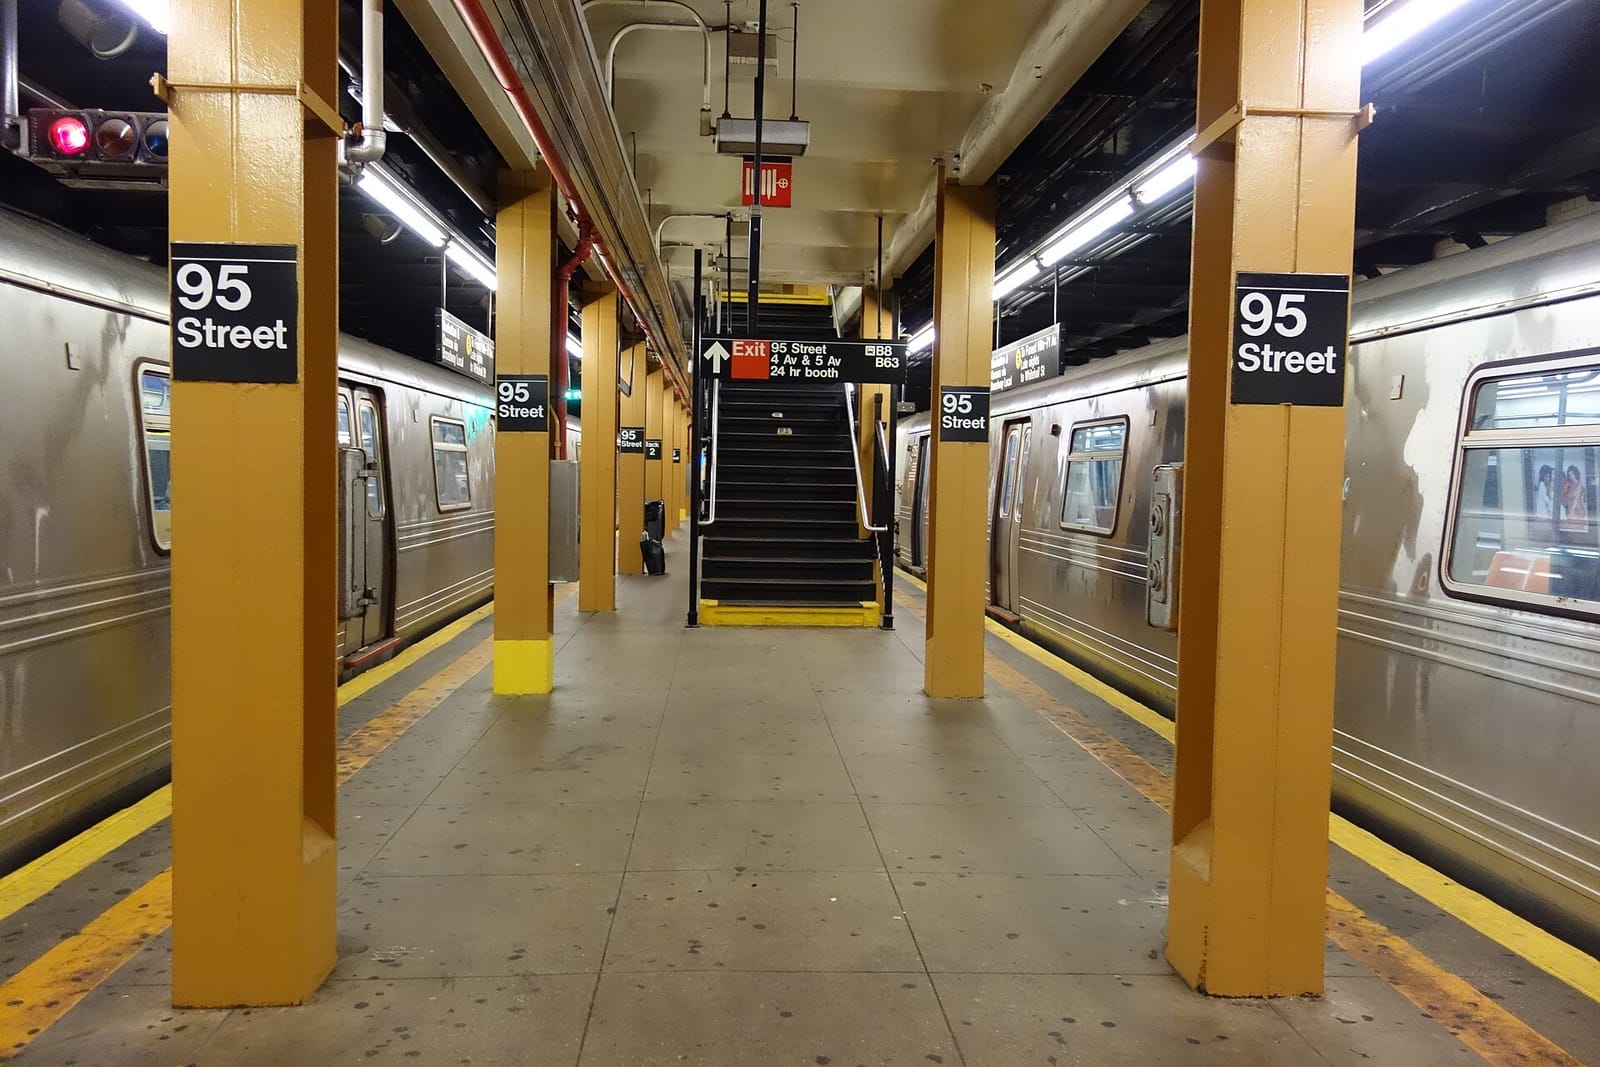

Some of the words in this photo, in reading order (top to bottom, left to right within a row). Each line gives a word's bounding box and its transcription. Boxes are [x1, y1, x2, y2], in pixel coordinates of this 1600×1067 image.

[177, 263, 251, 311] 95
[1240, 292, 1308, 338] 95
[178, 316, 288, 350] Street
[732, 341, 766, 357] Exit
[770, 342, 788, 353] 95
[791, 342, 828, 355] Street
[876, 345, 893, 357] B8
[770, 353, 779, 365] 4
[783, 354, 798, 365] Av
[801, 355, 811, 366] &
[815, 355, 824, 366] 5
[827, 355, 842, 367] Av
[875, 356, 900, 369] B63
[1237, 342, 1337, 374] Street
[770, 365, 786, 377] 24
[789, 366, 802, 377] hr
[804, 366, 839, 378] booth
[499, 383, 530, 402] 95
[943, 394, 972, 413] 95
[499, 404, 544, 418] Street
[942, 416, 986, 429] Street
[621, 430, 636, 440] 95
[621, 440, 642, 448] Street
[649, 448, 656, 456] 2
